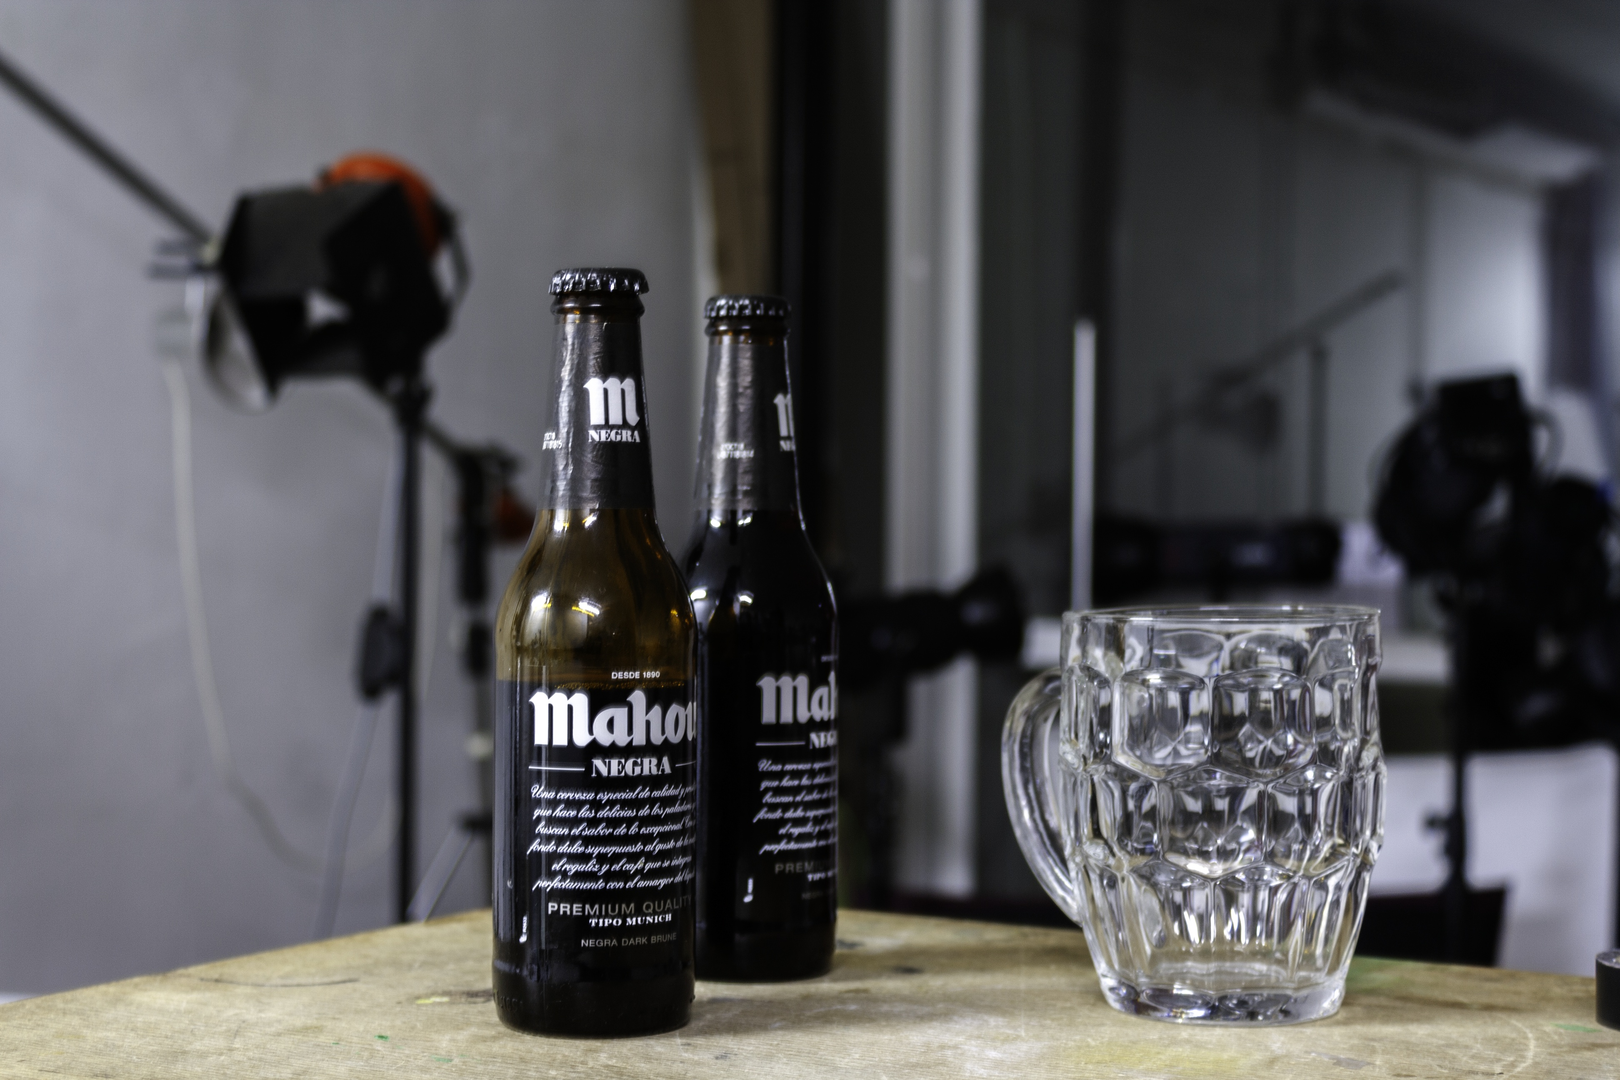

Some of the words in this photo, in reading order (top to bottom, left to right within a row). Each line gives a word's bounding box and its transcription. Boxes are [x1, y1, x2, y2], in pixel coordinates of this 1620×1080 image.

[588, 429, 640, 443] NEGRA
[611, 671, 640, 679] DESDE
[643, 671, 660, 679] 1890
[591, 756, 672, 777] NEGRA
[531, 784, 556, 799] Una
[556, 790, 595, 800] cerveza
[597, 785, 643, 804] especial
[638, 787, 651, 799] de
[651, 784, 682, 798] calidad
[532, 807, 552, 820] que
[552, 804, 577, 817] hace
[578, 804, 595, 818] las
[597, 804, 637, 818] delicias
[637, 804, 651, 817] de
[651, 802, 663, 815] los
[535, 821, 569, 835] buscan
[570, 822, 587, 836] el
[582, 822, 613, 836] sabor
[613, 823, 627, 836] de
[628, 821, 639, 836] lo
[526, 838, 556, 855] fondo
[557, 840, 585, 854] dulce
[585, 842, 643, 858] superpuesto
[644, 838, 659, 852] al
[652, 839, 675, 855] gusto
[551, 858, 567, 871] el
[562, 858, 601, 875] regaliz
[597, 864, 610, 876] y
[611, 858, 627, 872] el
[644, 861, 661, 873] que
[662, 859, 671, 868] se
[532, 875, 606, 892] perfectamente
[606, 881, 624, 890] con
[626, 875, 641, 889] el
[548, 902, 635, 916] PREMIUM
[642, 895, 692, 914] QUALITY
[588, 918, 622, 928] TIPO
[626, 913, 672, 926] MUNICH
[581, 938, 618, 948] NEGRA
[621, 936, 648, 946] DARK
[650, 932, 677, 944] BRUNE
